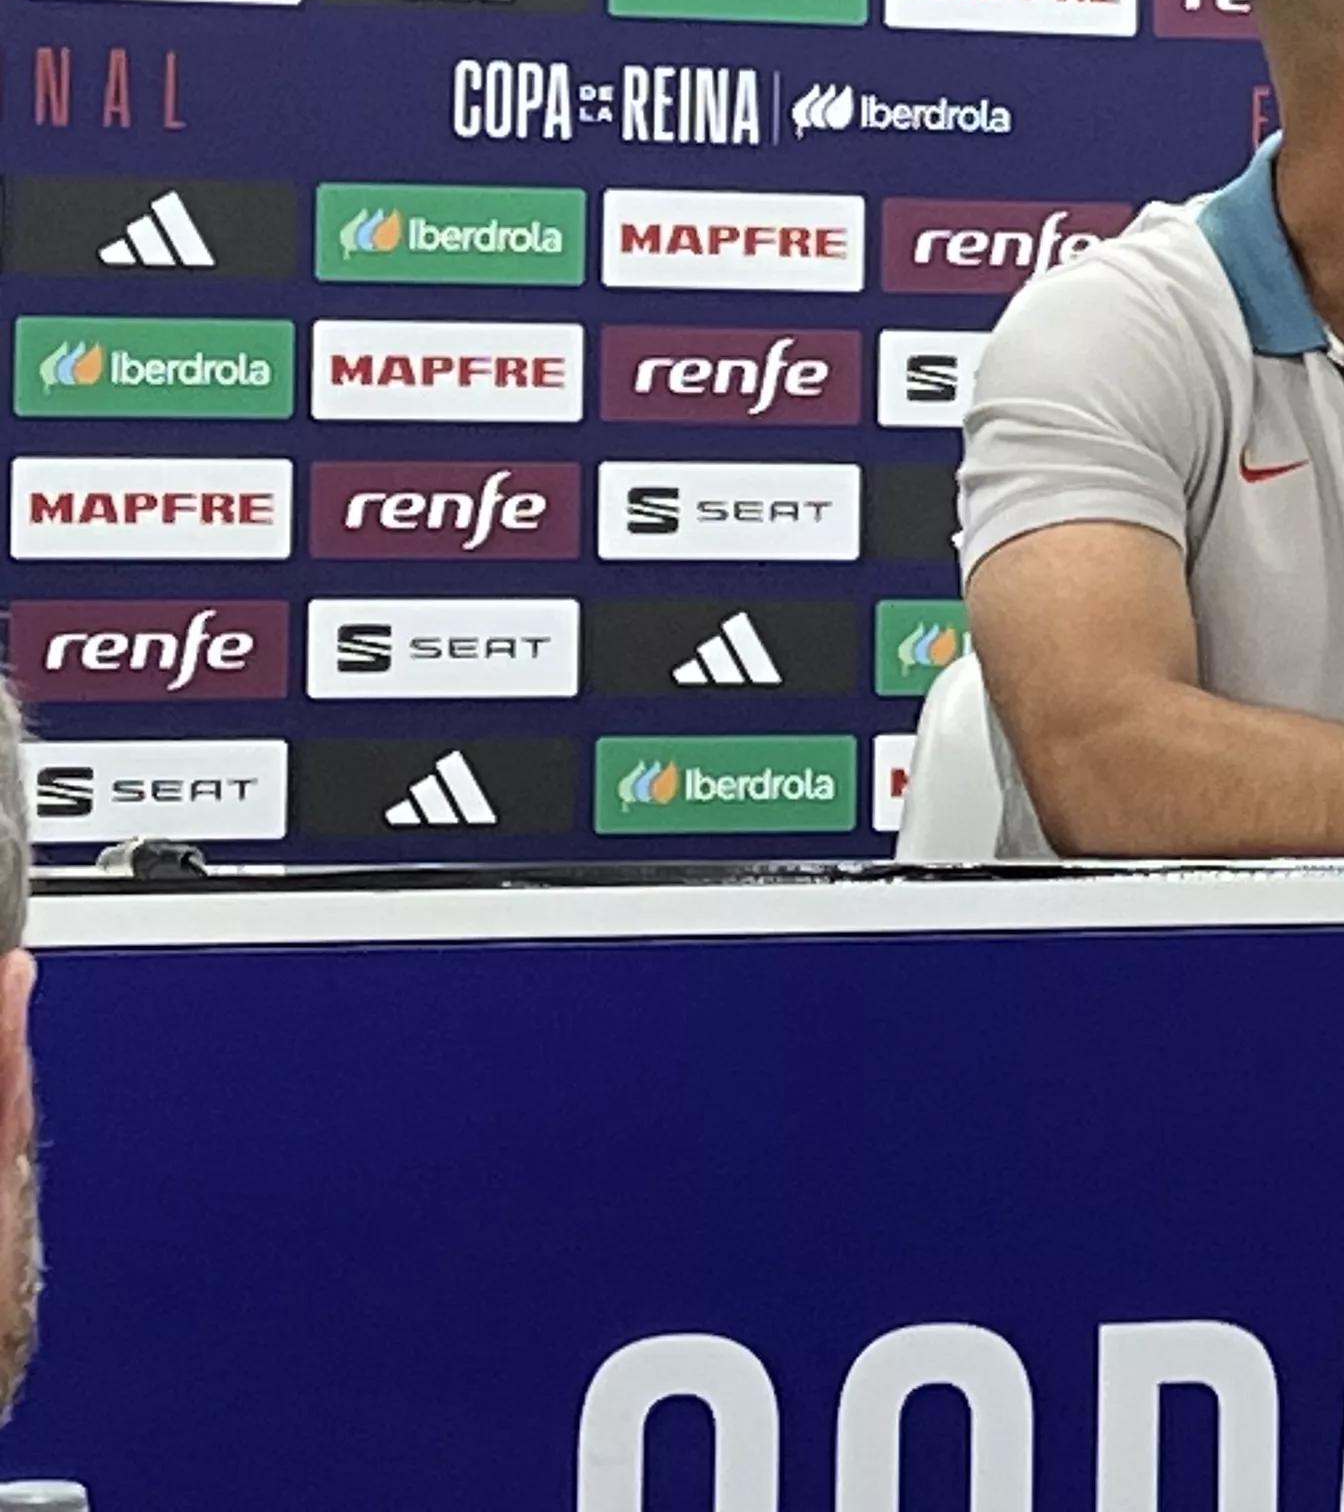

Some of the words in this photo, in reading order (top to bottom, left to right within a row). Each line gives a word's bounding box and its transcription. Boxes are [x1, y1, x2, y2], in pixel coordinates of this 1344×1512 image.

[455, 60, 571, 140] COPA
[623, 66, 759, 144] REINA
[862, 95, 1010, 132] Iberdrola
[410, 219, 562, 252] Iberdrola
[621, 224, 845, 257] MAPFRE
[112, 352, 269, 385] Iberdrola
[332, 355, 563, 387] MAPFRE
[636, 339, 827, 414] renfe
[31, 493, 272, 523] MAPFRE
[346, 471, 545, 549] renfe
[697, 501, 831, 521] SEAT
[47, 610, 252, 690] renfe
[410, 638, 549, 658] SEAT
[113, 780, 253, 802] SEAT
[686, 768, 833, 800] Iberdrola
